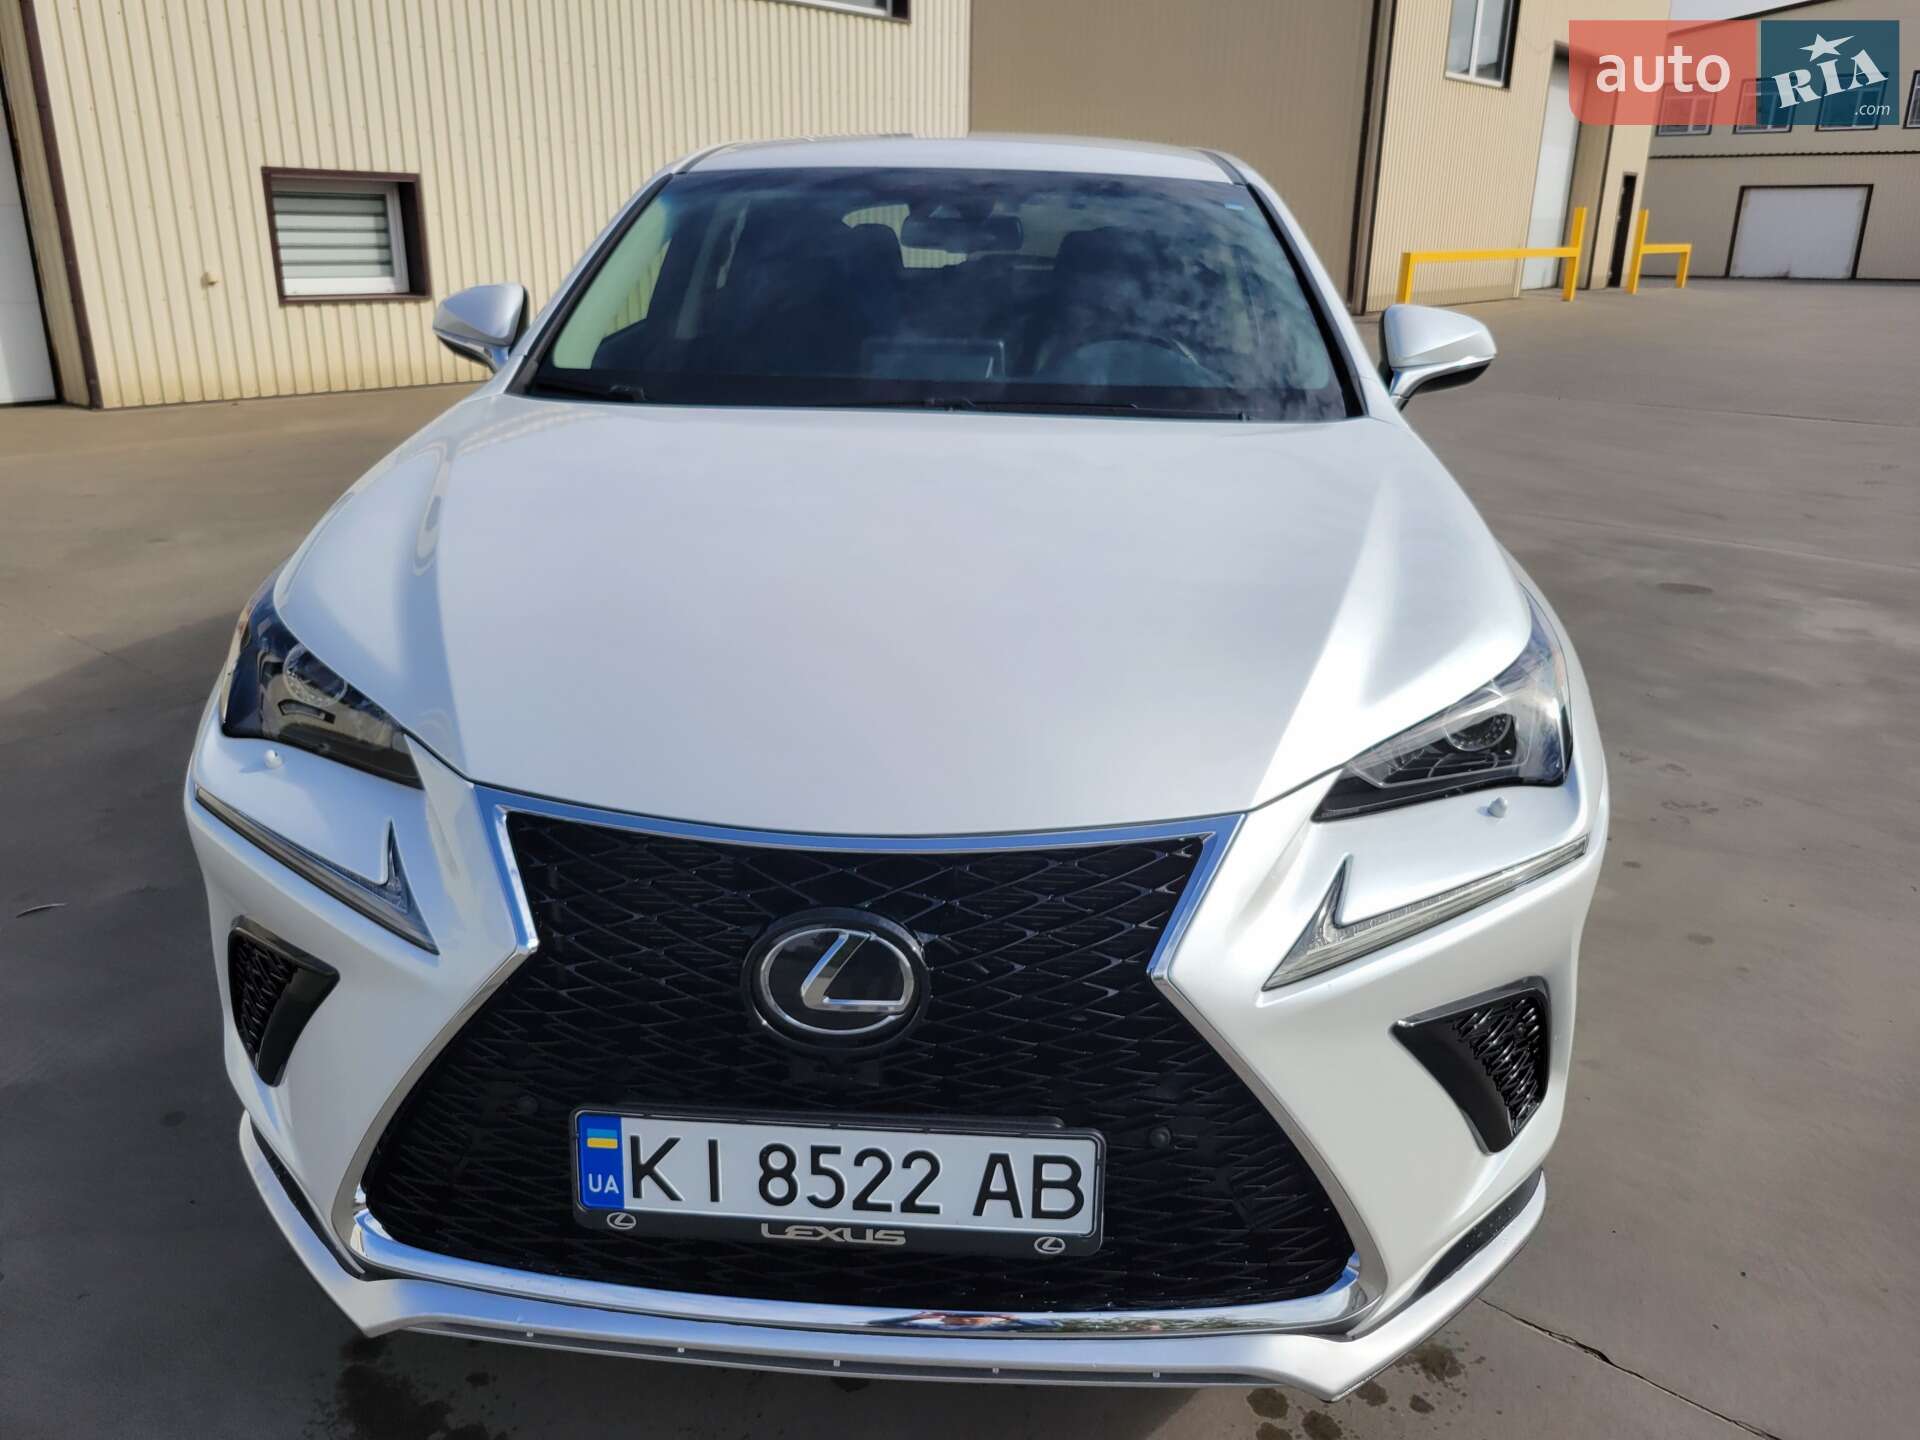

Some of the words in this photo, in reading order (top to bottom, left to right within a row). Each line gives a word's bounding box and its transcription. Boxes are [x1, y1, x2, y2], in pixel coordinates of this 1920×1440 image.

[587, 1172, 620, 1194] UA
[629, 1134, 720, 1203] KI
[758, 1142, 942, 1214] 8522
[972, 1152, 1085, 1220] AB
[761, 1222, 906, 1246] LEXUS
